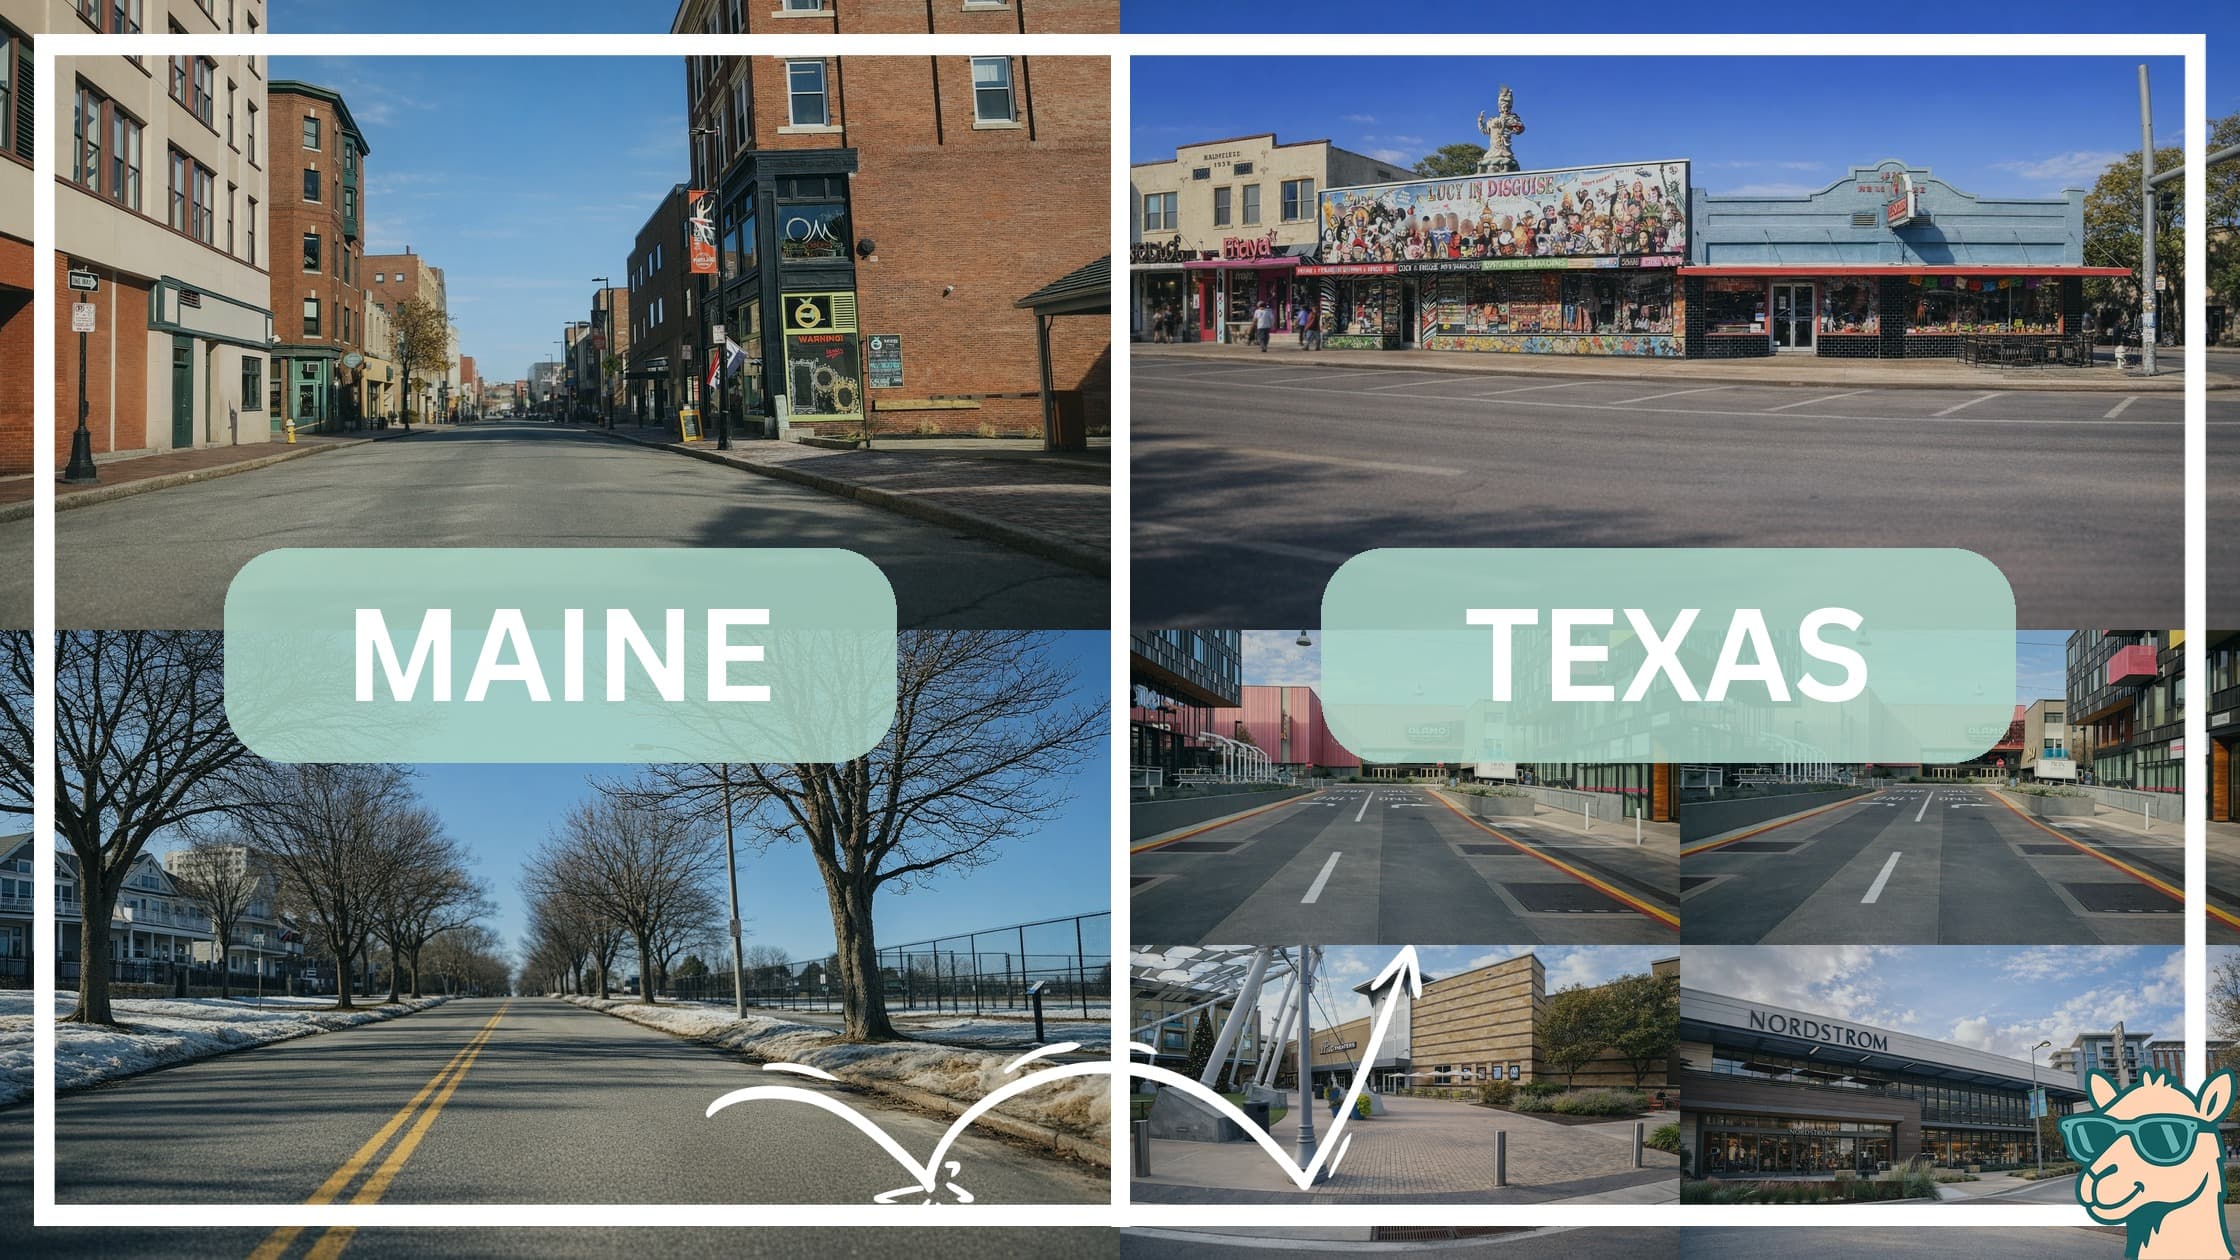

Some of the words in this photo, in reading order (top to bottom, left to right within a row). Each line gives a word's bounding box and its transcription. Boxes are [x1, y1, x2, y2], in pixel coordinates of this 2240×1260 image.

[1427, 182, 1464, 201] LUCY
[1468, 182, 1483, 199] IN
[1487, 176, 1555, 198] DISGUISE
[1750, 1010, 1888, 1051] NORDSTROM
